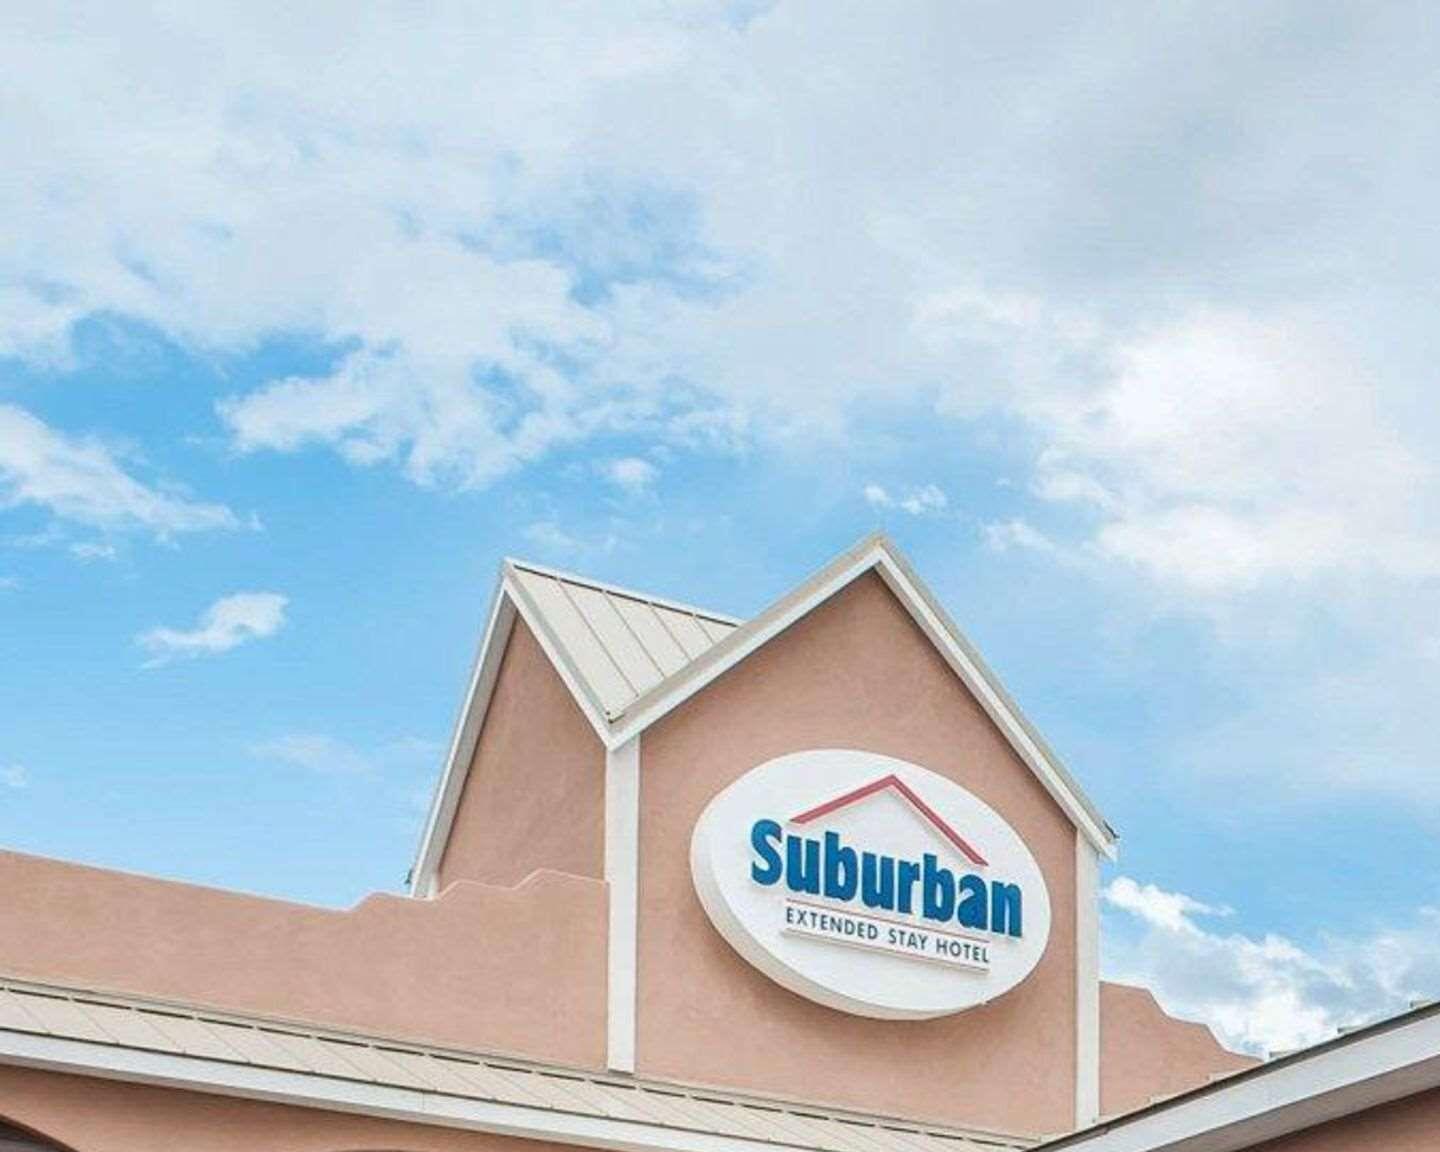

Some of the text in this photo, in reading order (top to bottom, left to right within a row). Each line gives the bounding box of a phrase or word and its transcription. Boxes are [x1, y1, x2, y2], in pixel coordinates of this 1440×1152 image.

[751, 819, 1022, 937] Suburban
[786, 908, 990, 963] EXTENDED STAY HOTEL
